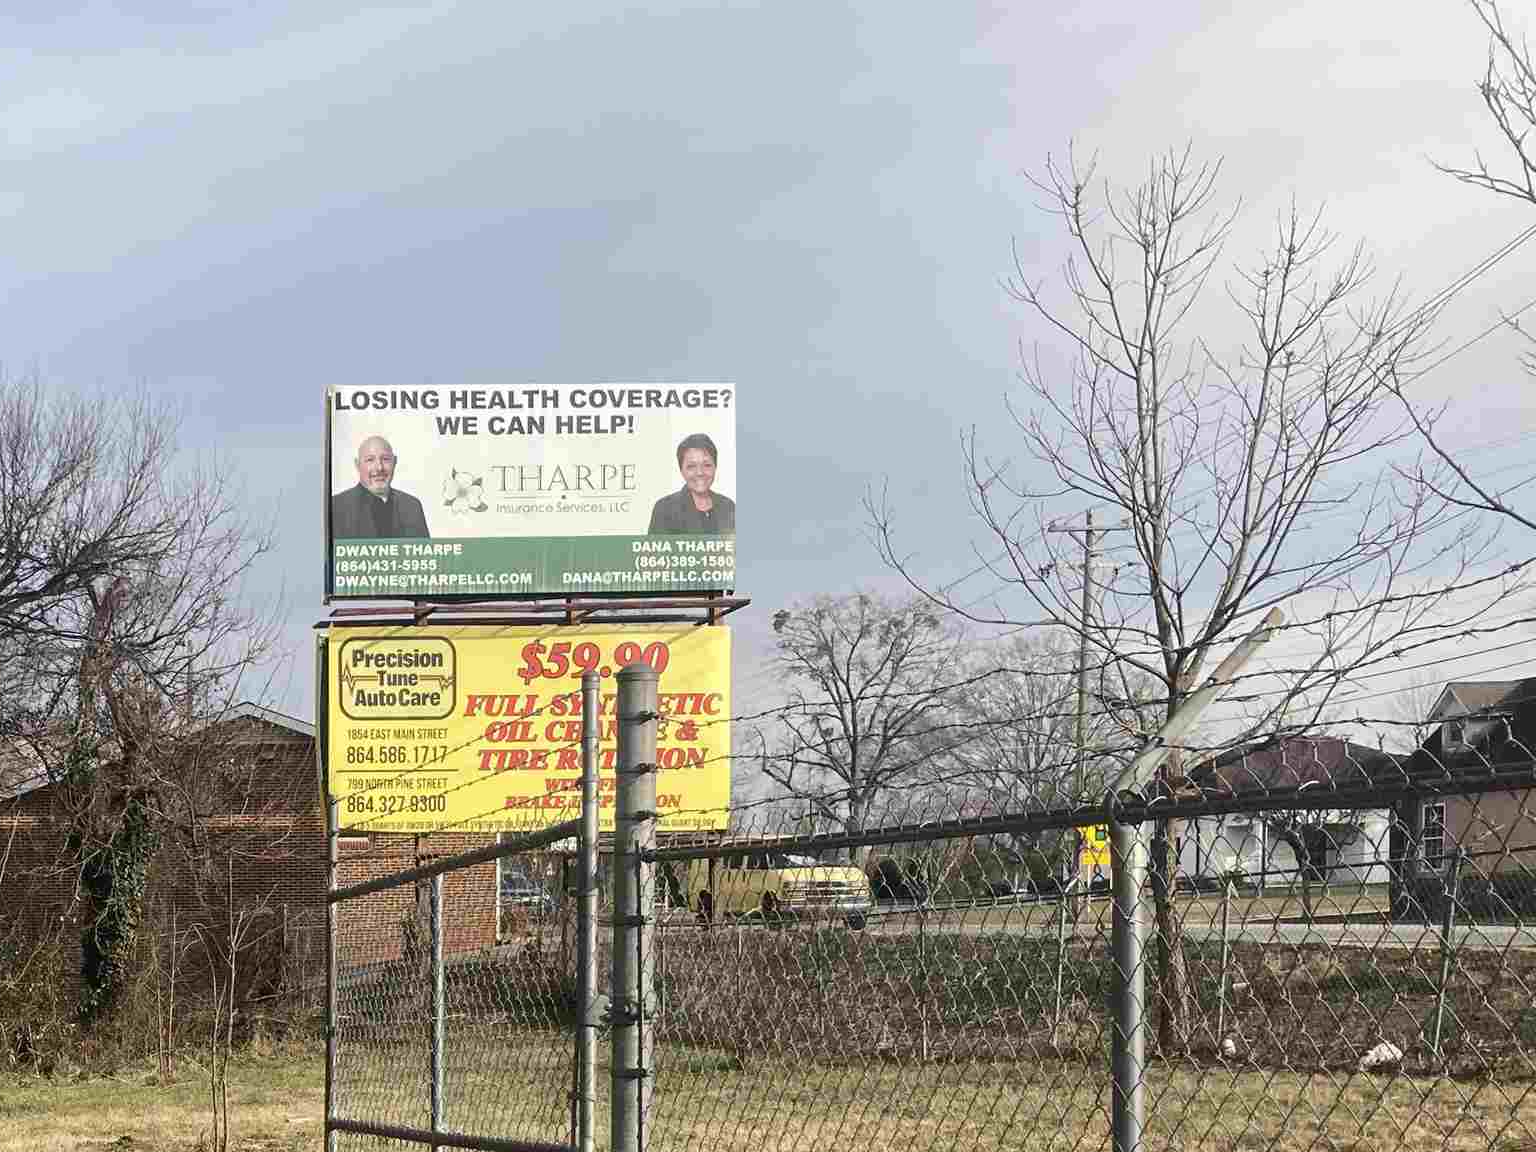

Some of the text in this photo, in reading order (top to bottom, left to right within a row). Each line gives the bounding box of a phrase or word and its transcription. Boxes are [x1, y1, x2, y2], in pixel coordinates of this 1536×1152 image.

[335, 389, 733, 411] LOSING HEALTH COVERAGE?
[436, 414, 634, 436] WE CAN HELP!
[491, 464, 636, 492] THARPE
[495, 502, 553, 514] Insurance
[335, 543, 463, 557] DWAYNE THARPE
[632, 540, 734, 553] DANA THARPE
[335, 559, 437, 574] (864)431-5955
[335, 573, 533, 588] DWAYNE@THARPELLC.COM
[562, 570, 734, 585] DANA@THARPELLC.COM
[352, 648, 443, 668] Precision
[377, 670, 419, 686] Tune
[463, 693, 539, 717] FULL
[370, 728, 391, 740] EAST
[393, 728, 415, 740] MAIN
[417, 727, 449, 740] STREET
[483, 719, 539, 742] OIL
[674, 719, 700, 741] &
[346, 745, 449, 764] 864.586.1717
[478, 748, 549, 771] TIRE
[395, 777, 415, 789] PINE
[416, 777, 449, 789] STREET
[346, 795, 446, 813] 864.327.9300
